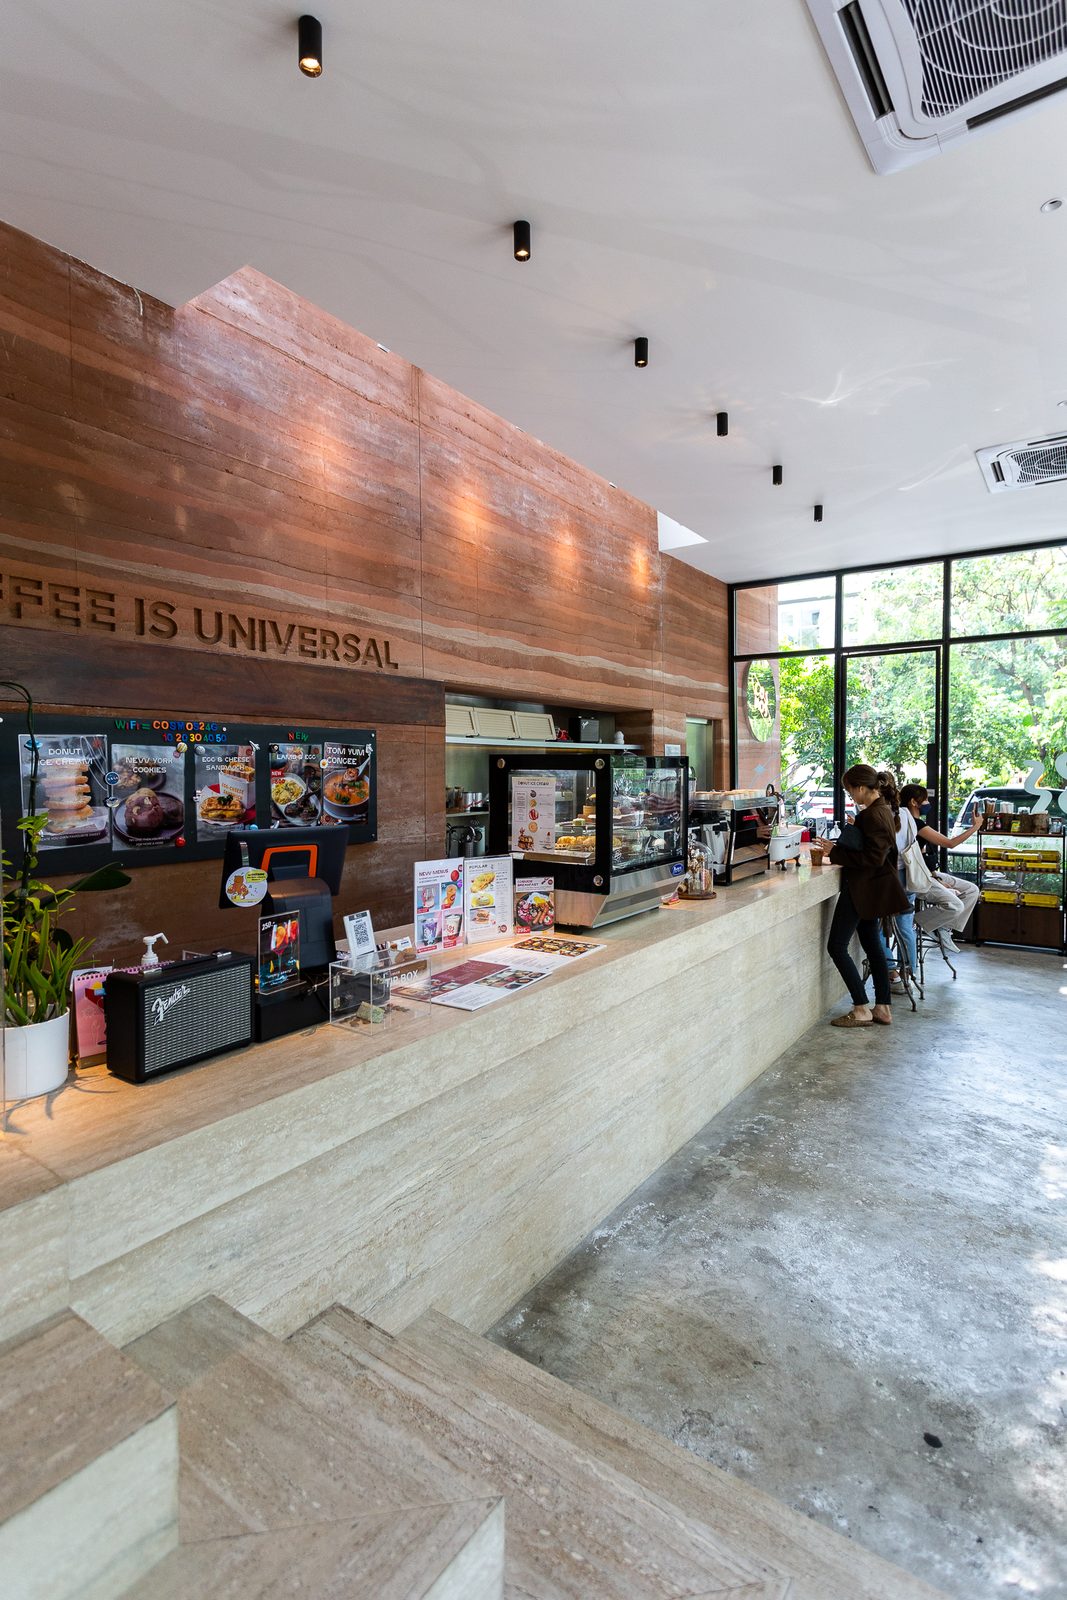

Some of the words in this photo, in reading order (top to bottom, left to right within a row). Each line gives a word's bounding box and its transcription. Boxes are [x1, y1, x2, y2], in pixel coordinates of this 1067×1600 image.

[0, 573, 116, 632] FEE
[134, 598, 179, 640] IS
[194, 607, 400, 670] UNIVERSAL
[287, 731, 309, 742] NEW
[48, 748, 81, 756] DONUT
[327, 747, 346, 755] TOM
[347, 748, 365, 757] YUM
[55, 757, 93, 767] CREAM
[327, 757, 357, 766] CONGEE
[132, 766, 167, 774] COOKIES
[400, 969, 419, 984] BOX
[151, 984, 191, 1026] Fender
